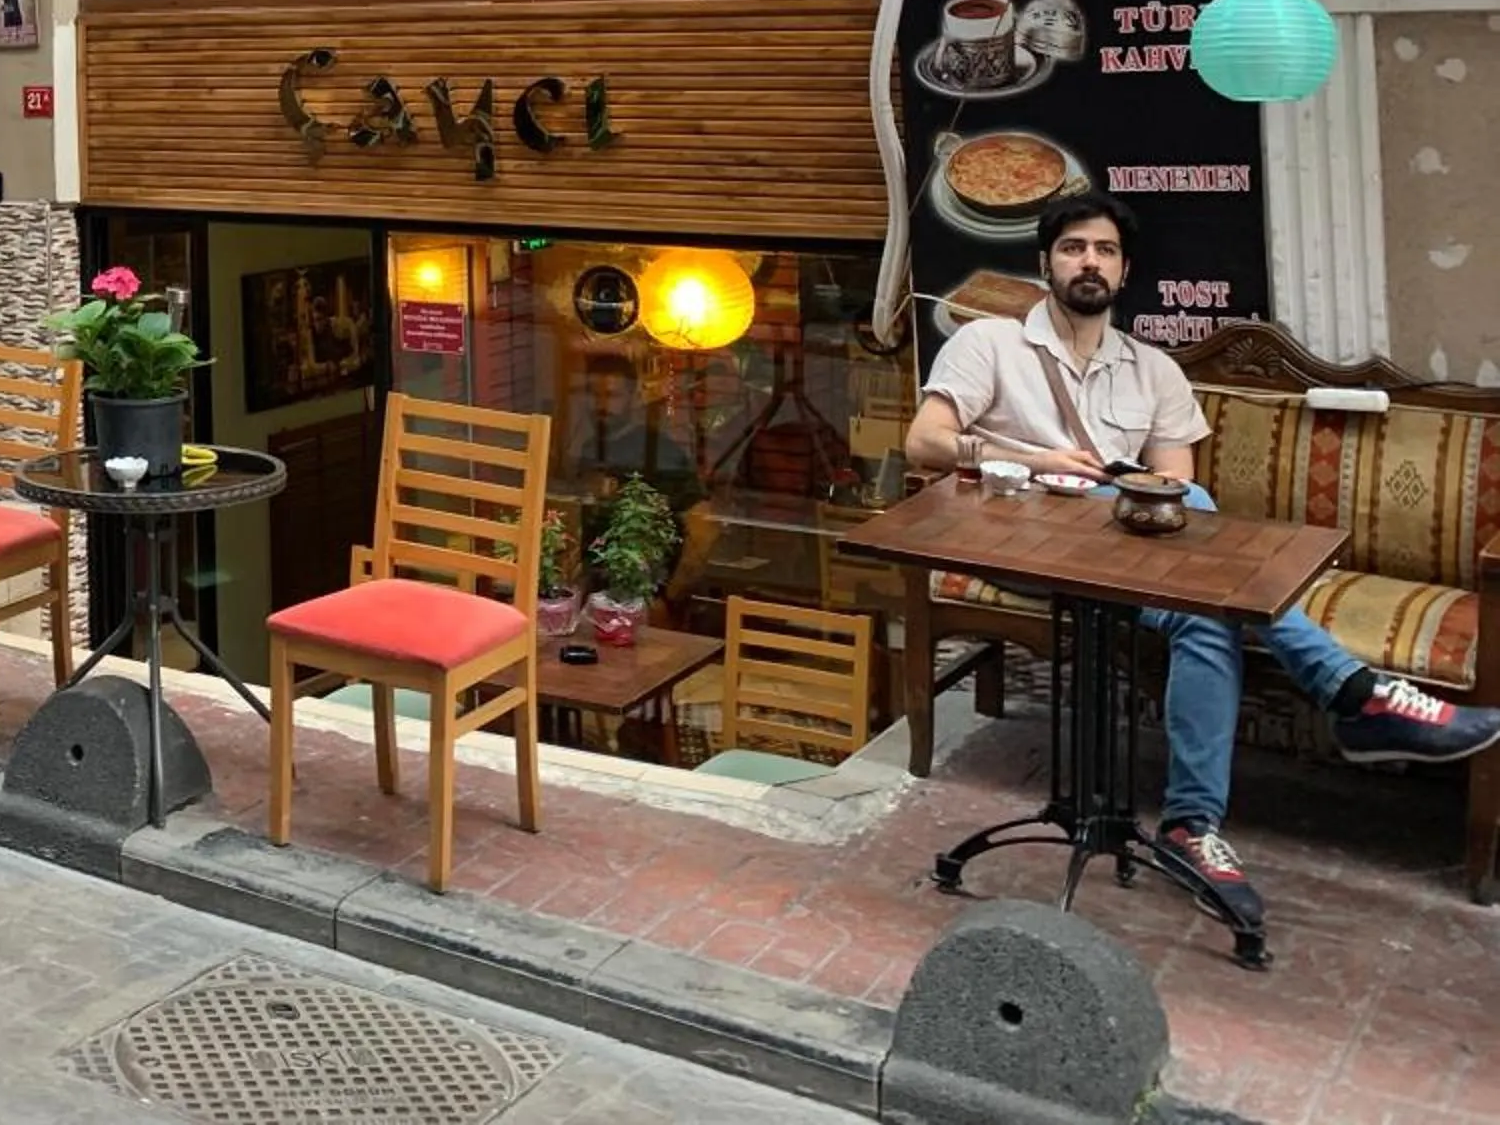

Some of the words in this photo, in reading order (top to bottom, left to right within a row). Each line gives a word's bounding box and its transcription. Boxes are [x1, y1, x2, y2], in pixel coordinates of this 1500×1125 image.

[1113, 0, 1207, 34] TÜR
[1107, 164, 1251, 193] MENEMEN
[1157, 280, 1230, 308] TOST
